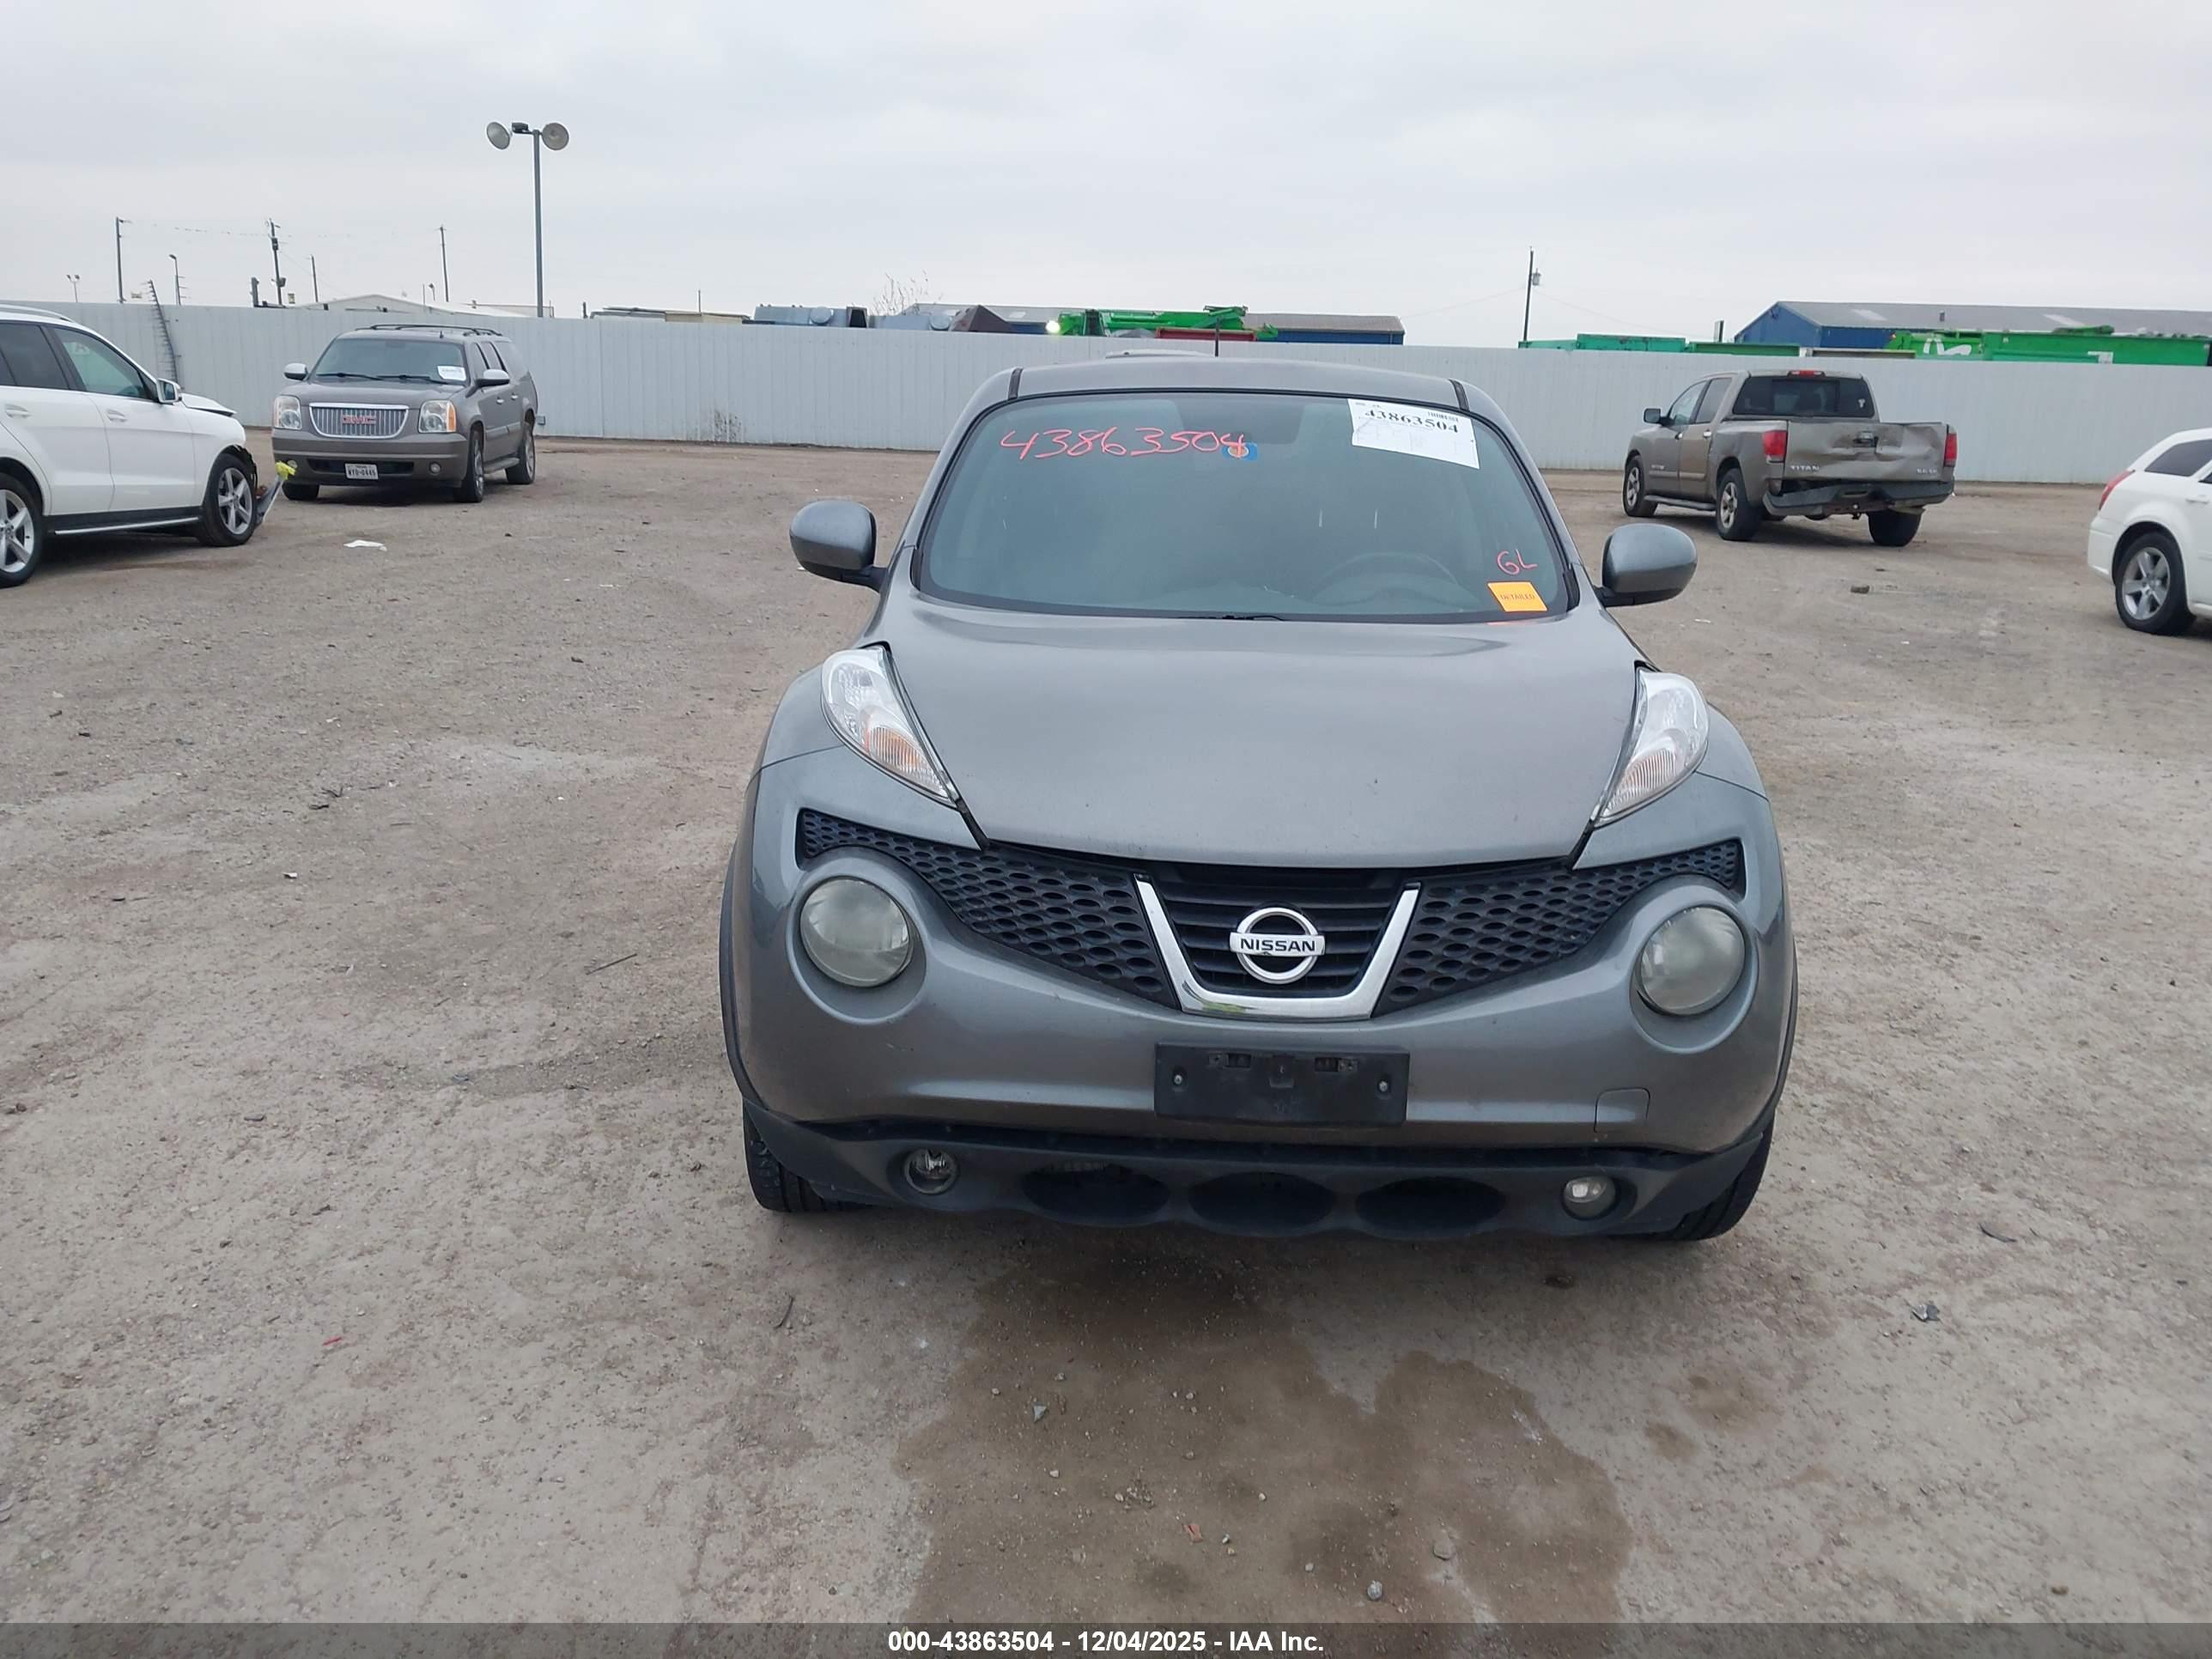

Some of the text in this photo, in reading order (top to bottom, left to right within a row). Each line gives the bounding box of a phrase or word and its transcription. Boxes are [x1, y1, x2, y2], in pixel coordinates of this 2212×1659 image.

[1364, 409, 1458, 433] 43863504
[1000, 426, 1244, 459] 43863504
[1240, 938, 1316, 951] NISSAN
